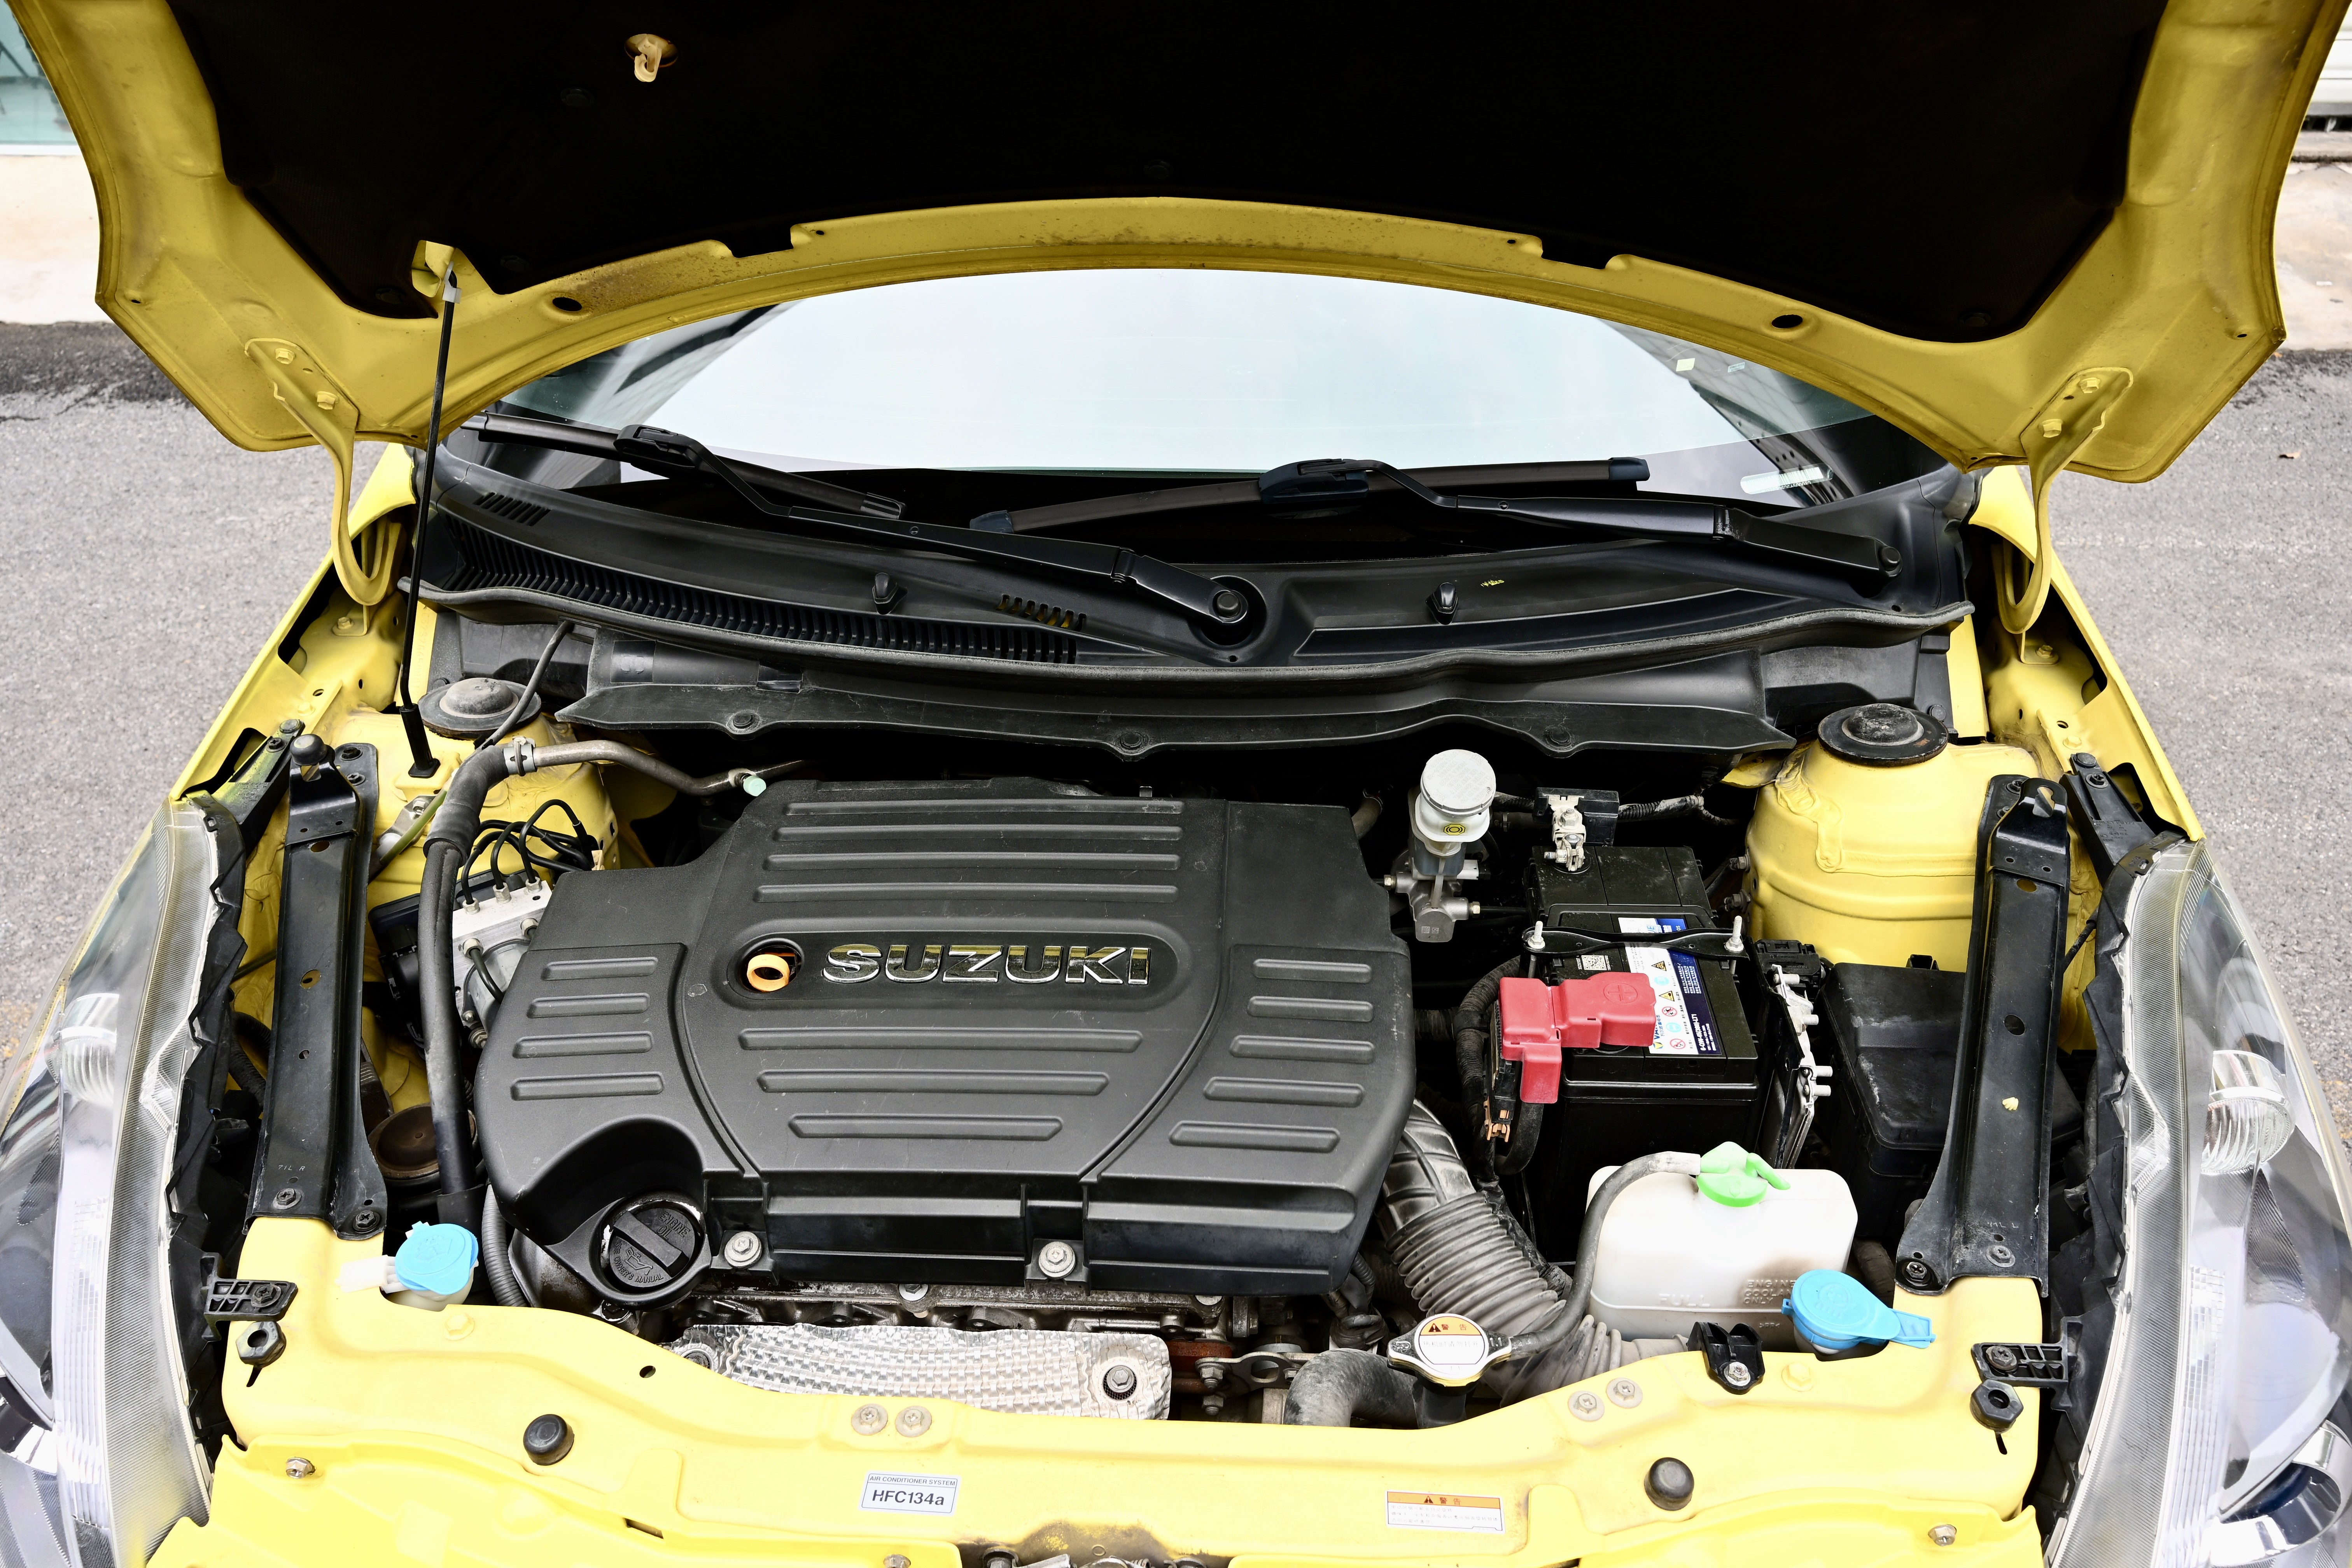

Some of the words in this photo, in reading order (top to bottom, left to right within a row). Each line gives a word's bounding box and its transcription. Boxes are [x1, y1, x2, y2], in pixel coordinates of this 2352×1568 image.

[822, 944, 1153, 985] SUZUKI
[659, 1211, 691, 1238] ENGINE
[657, 1225, 672, 1241] OIL
[613, 1241, 622, 1255] SEE
[614, 1256, 634, 1281] OWNER'S
[634, 1273, 664, 1283] MANUAL
[1747, 1279, 1796, 1288] ENGINE
[1745, 1288, 1792, 1297] COOLAN
[1658, 1293, 1710, 1307] FULL
[872, 1489, 944, 1505] HFC134a
[1439, 1496, 1461, 1505] 警告
